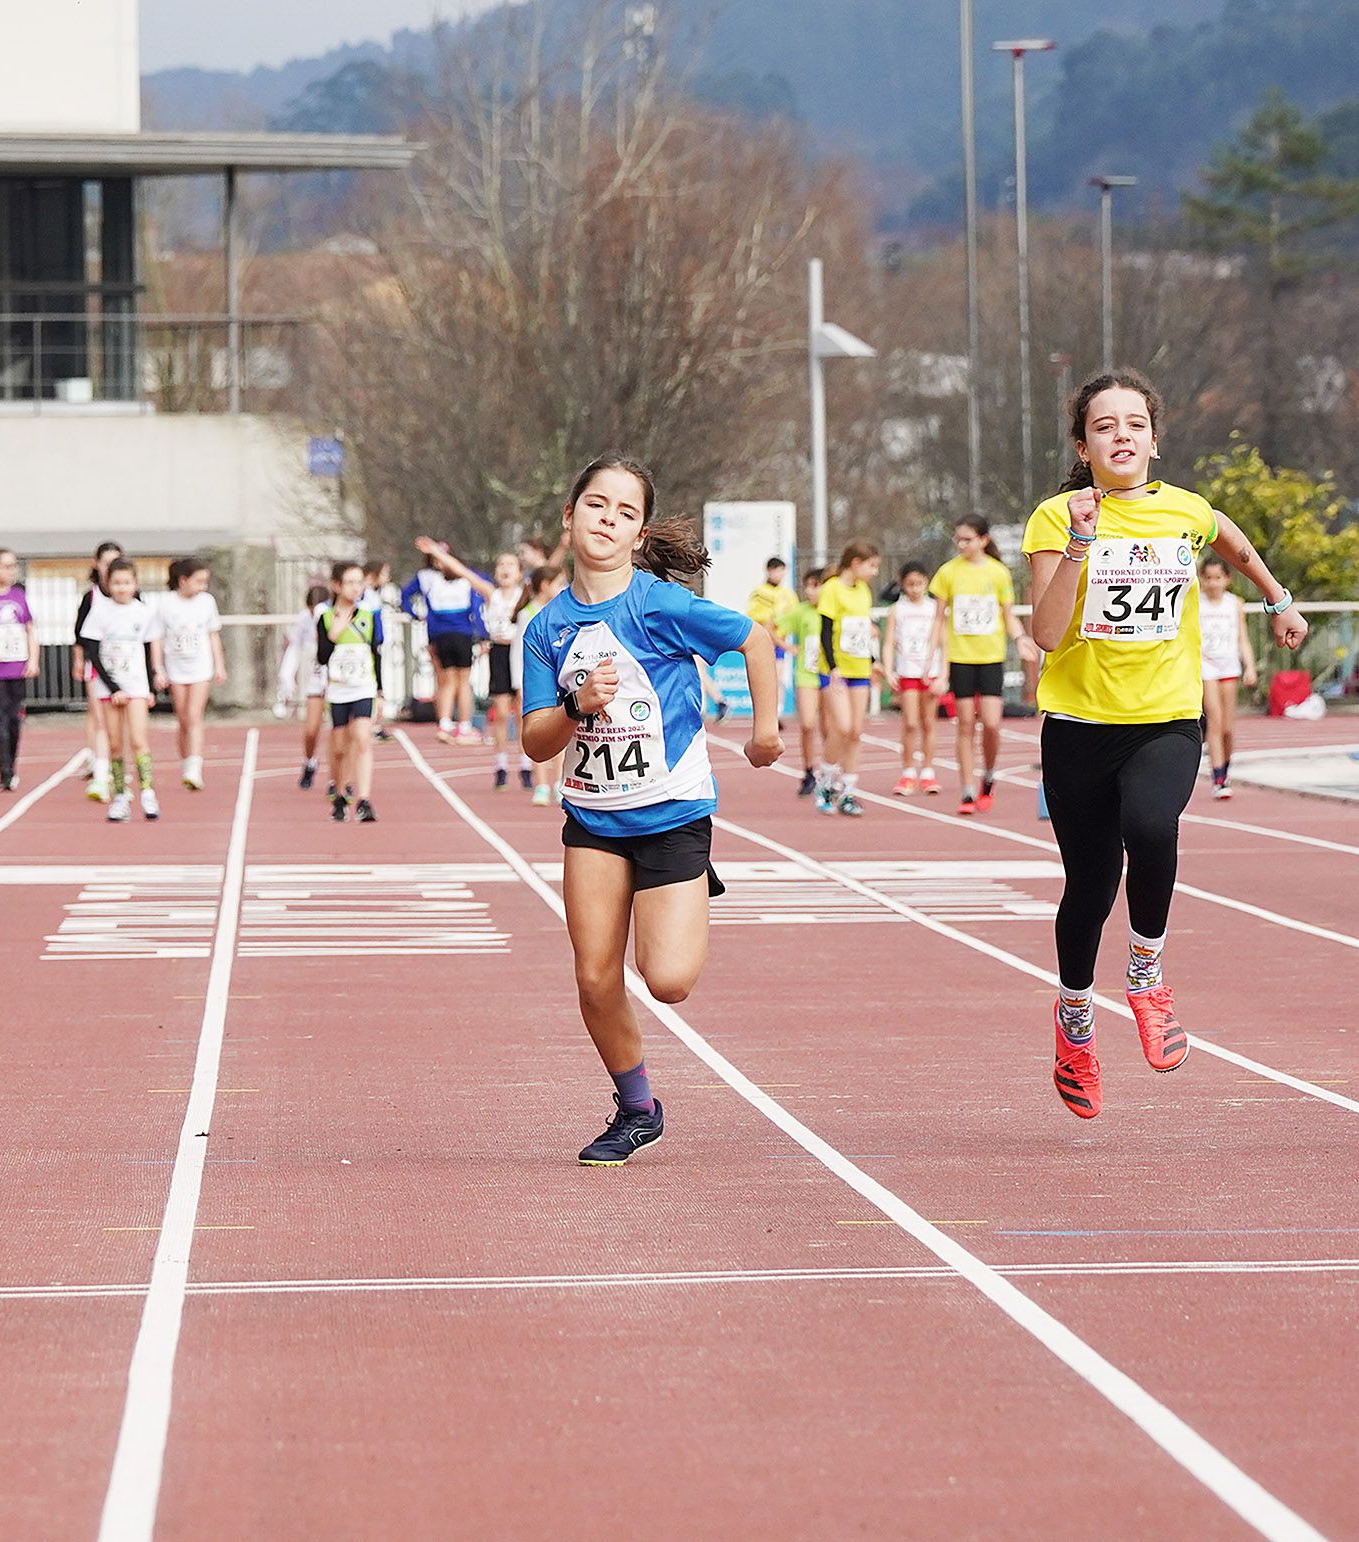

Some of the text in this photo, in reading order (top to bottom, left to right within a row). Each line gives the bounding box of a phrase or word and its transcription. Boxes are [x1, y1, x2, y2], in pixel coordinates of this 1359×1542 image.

[1103, 584, 1182, 622] 341
[617, 733, 651, 742] SPORTS
[574, 740, 650, 780] 214
